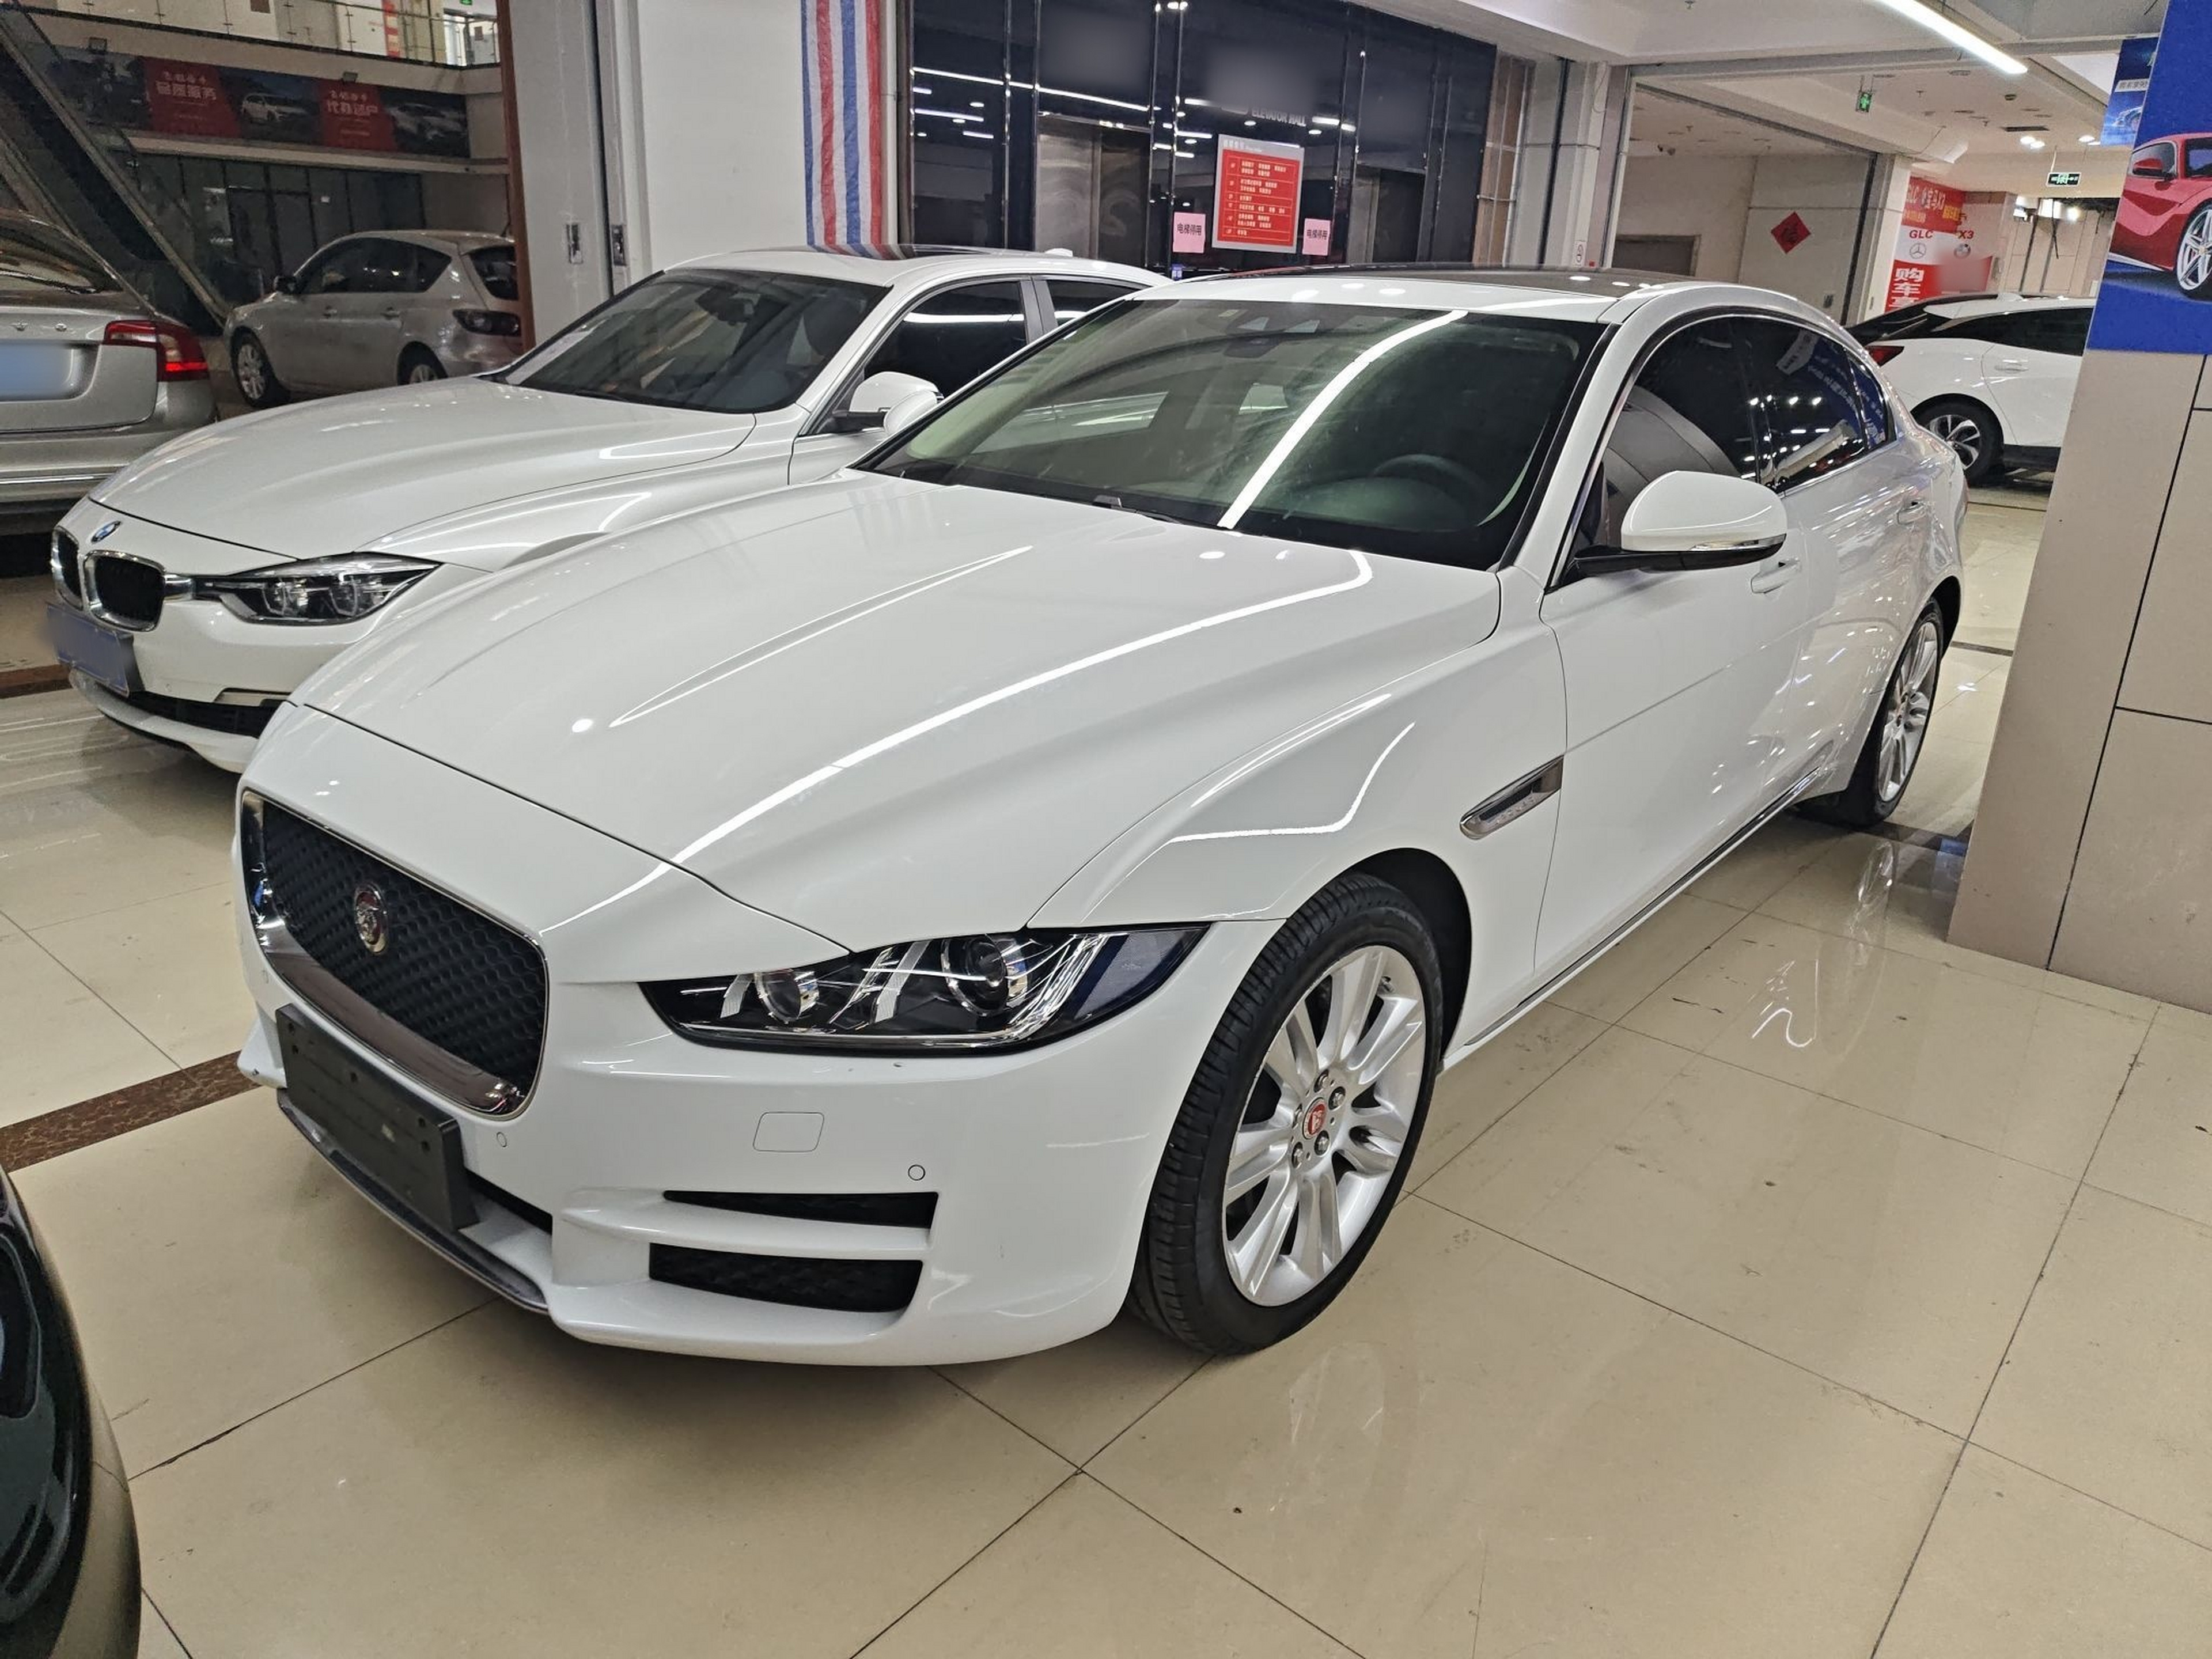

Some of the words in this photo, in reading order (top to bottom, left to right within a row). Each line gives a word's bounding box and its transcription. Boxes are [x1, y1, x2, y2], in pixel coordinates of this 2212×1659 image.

[1251, 107, 1287, 123] ELEVATOR
[1288, 113, 1306, 127] HALL
[1177, 223, 1202, 236] 电梯停用
[1909, 229, 1933, 238] GLC
[1958, 230, 1975, 240] X3
